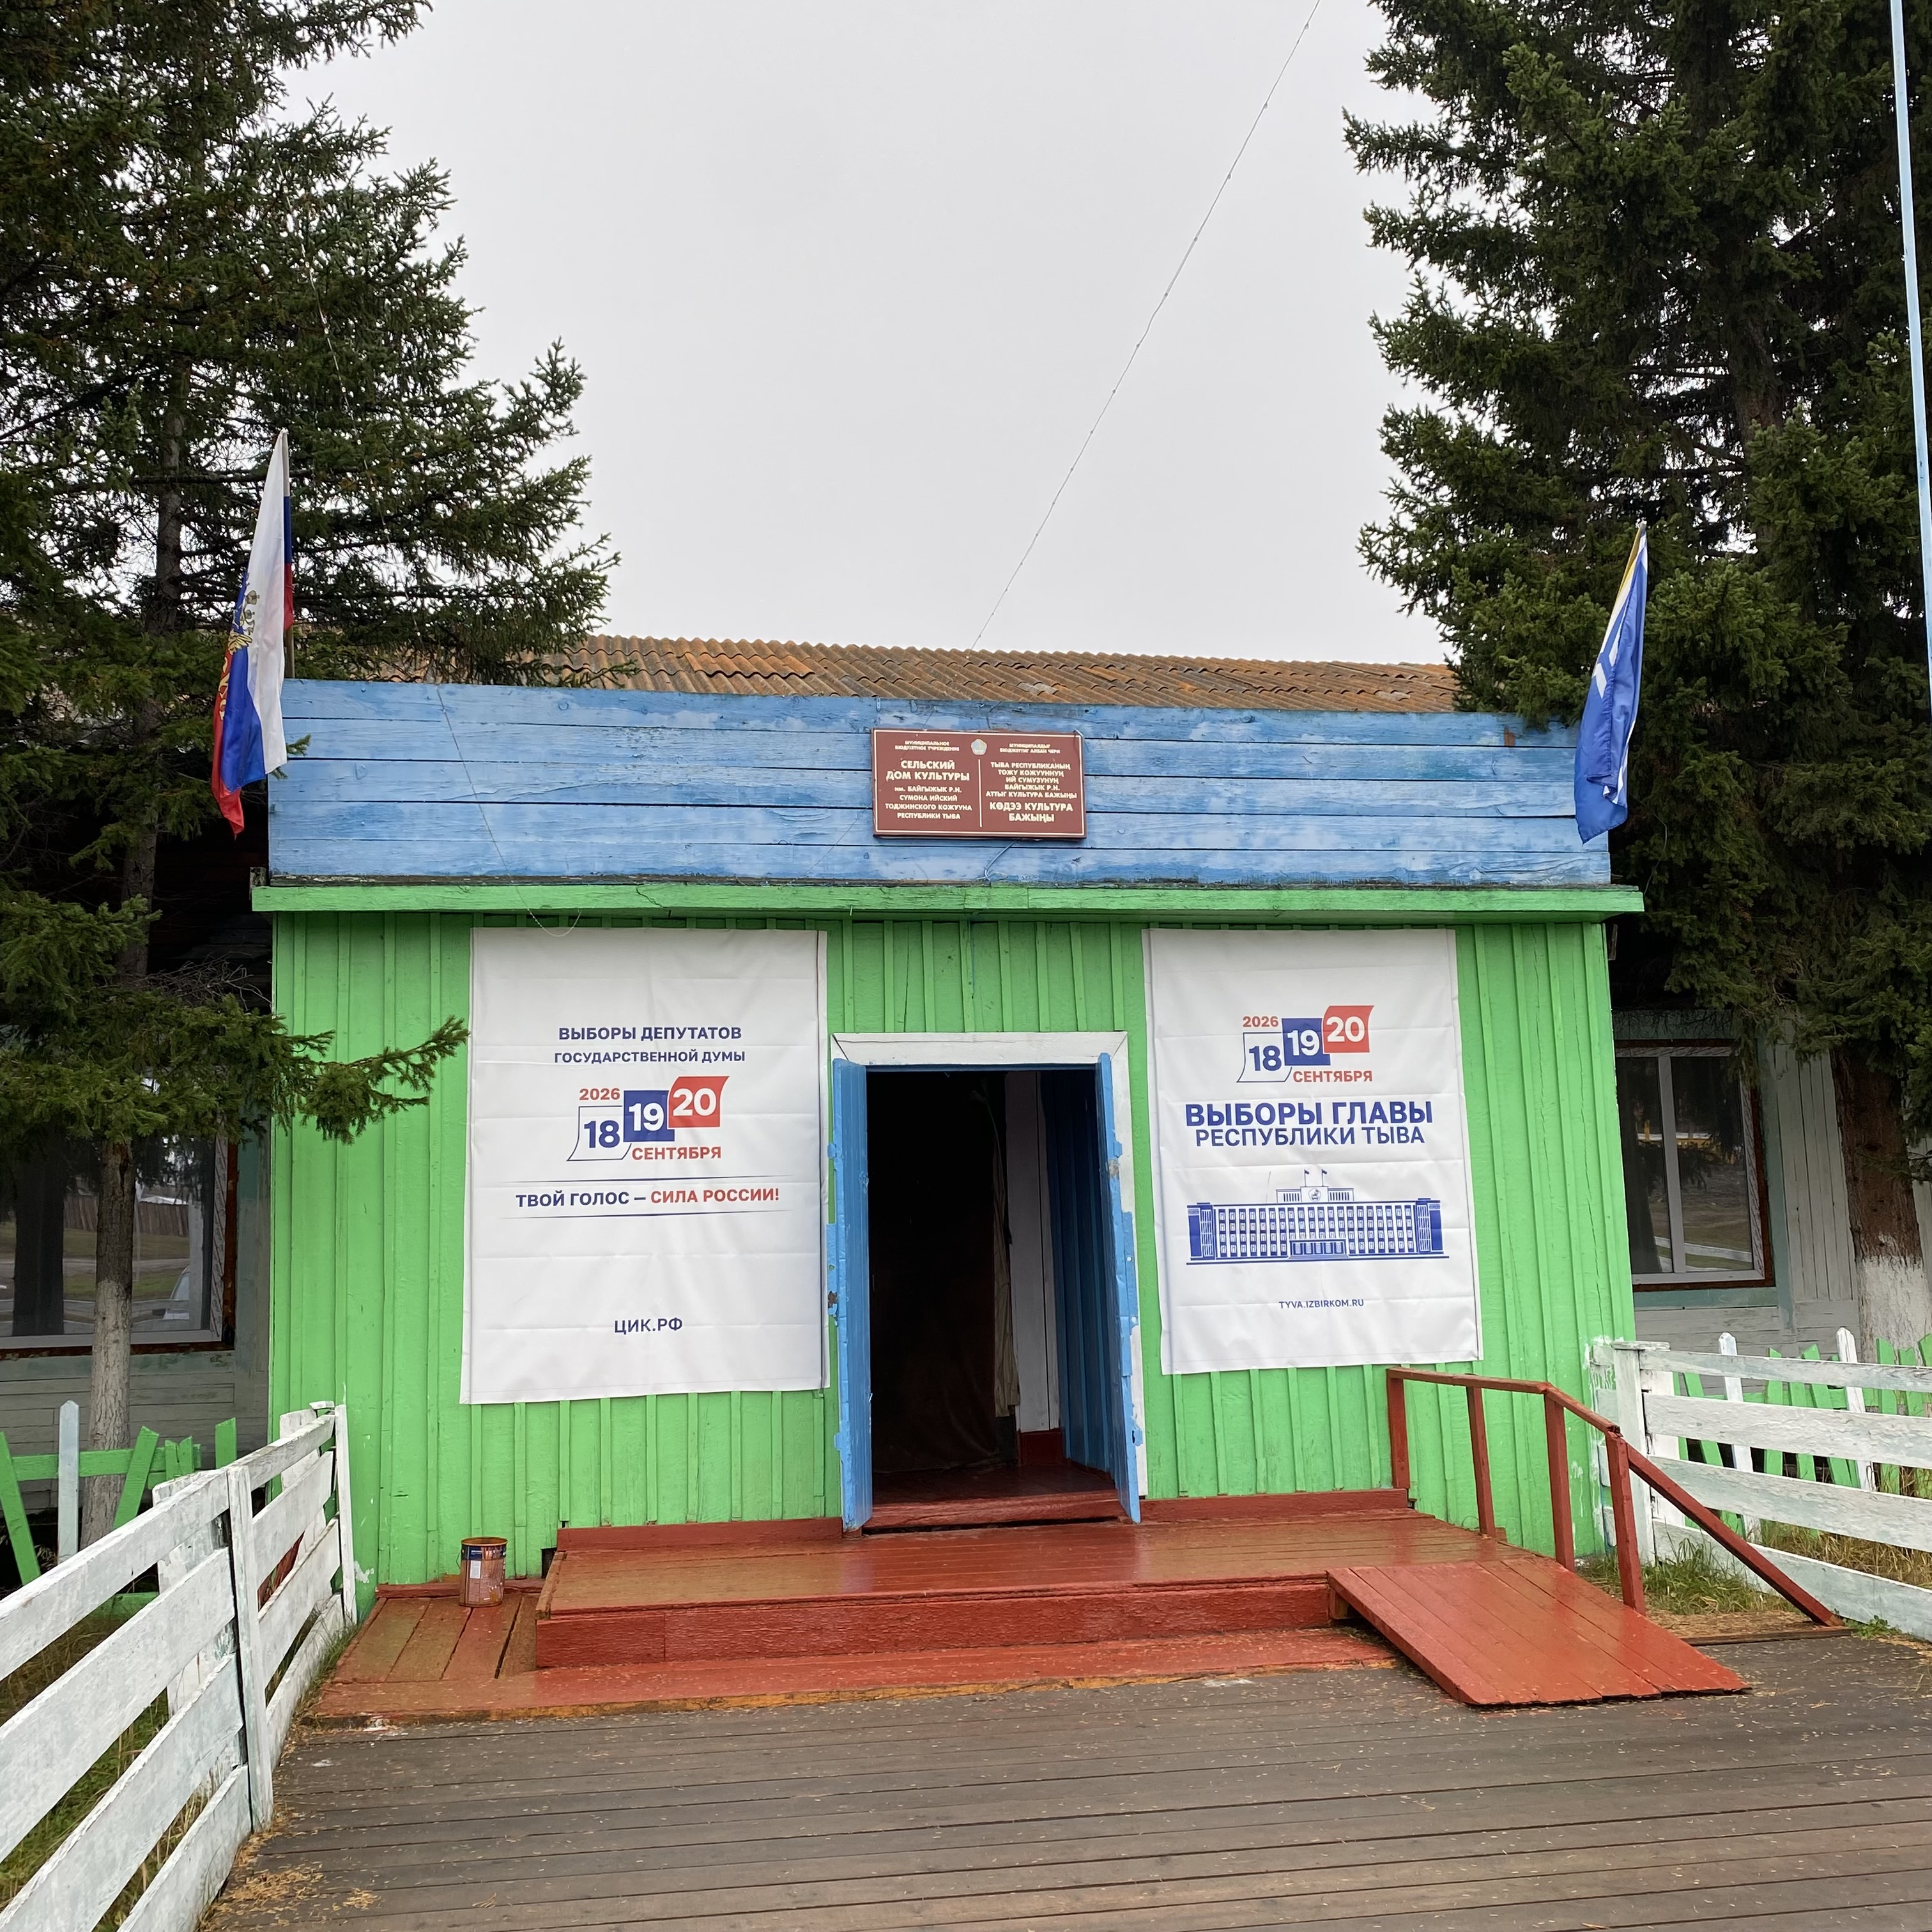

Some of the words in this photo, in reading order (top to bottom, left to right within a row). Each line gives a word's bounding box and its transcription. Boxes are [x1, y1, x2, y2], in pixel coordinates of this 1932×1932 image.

[901, 760, 955, 769] СЕЛЬСКИЙ
[886, 771, 911, 781] ДОМ
[914, 772, 970, 781] КУЛЬТУРЫ
[990, 802, 1022, 811] КӨДЭЭ
[1025, 802, 1073, 811] КУЛЬТУРА
[1009, 813, 1054, 823] БАЖЫҢЫ
[1243, 1016, 1278, 1027] 2026
[559, 1027, 636, 1039] ВЫБОРЫ
[641, 1027, 741, 1041] ДЕПУТАТОВ
[1249, 1045, 1282, 1071] 18
[1287, 1030, 1319, 1055] 19
[1326, 1016, 1365, 1042] 20
[555, 1049, 698, 1064] ГОСУДАРСТВЕННОЙ
[702, 1052, 744, 1063] ДУМЫ
[1293, 1071, 1372, 1082] СЕНТЯБРЯ
[579, 1088, 620, 1100] 2026
[584, 1120, 620, 1148] 18
[629, 1103, 664, 1131] 19
[673, 1088, 717, 1116] 20
[1186, 1103, 1322, 1126] ВЫБОРЫ
[1332, 1101, 1432, 1124] ГЛАВЫ
[1196, 1127, 1354, 1146] РЕСПУБЛИКИ
[1361, 1126, 1425, 1144] ТЫВА
[632, 1147, 721, 1160] СЕНТЯБРЯ
[516, 1190, 564, 1207] ТВОЙ
[571, 1192, 629, 1206] ГОЛОС
[651, 1190, 698, 1203] СИЛА
[703, 1188, 779, 1202] РОССИИ!
[1278, 1299, 1363, 1308] TYVA.IZBIRKOM.RU
[615, 1317, 682, 1335] ЦИК.РФ
